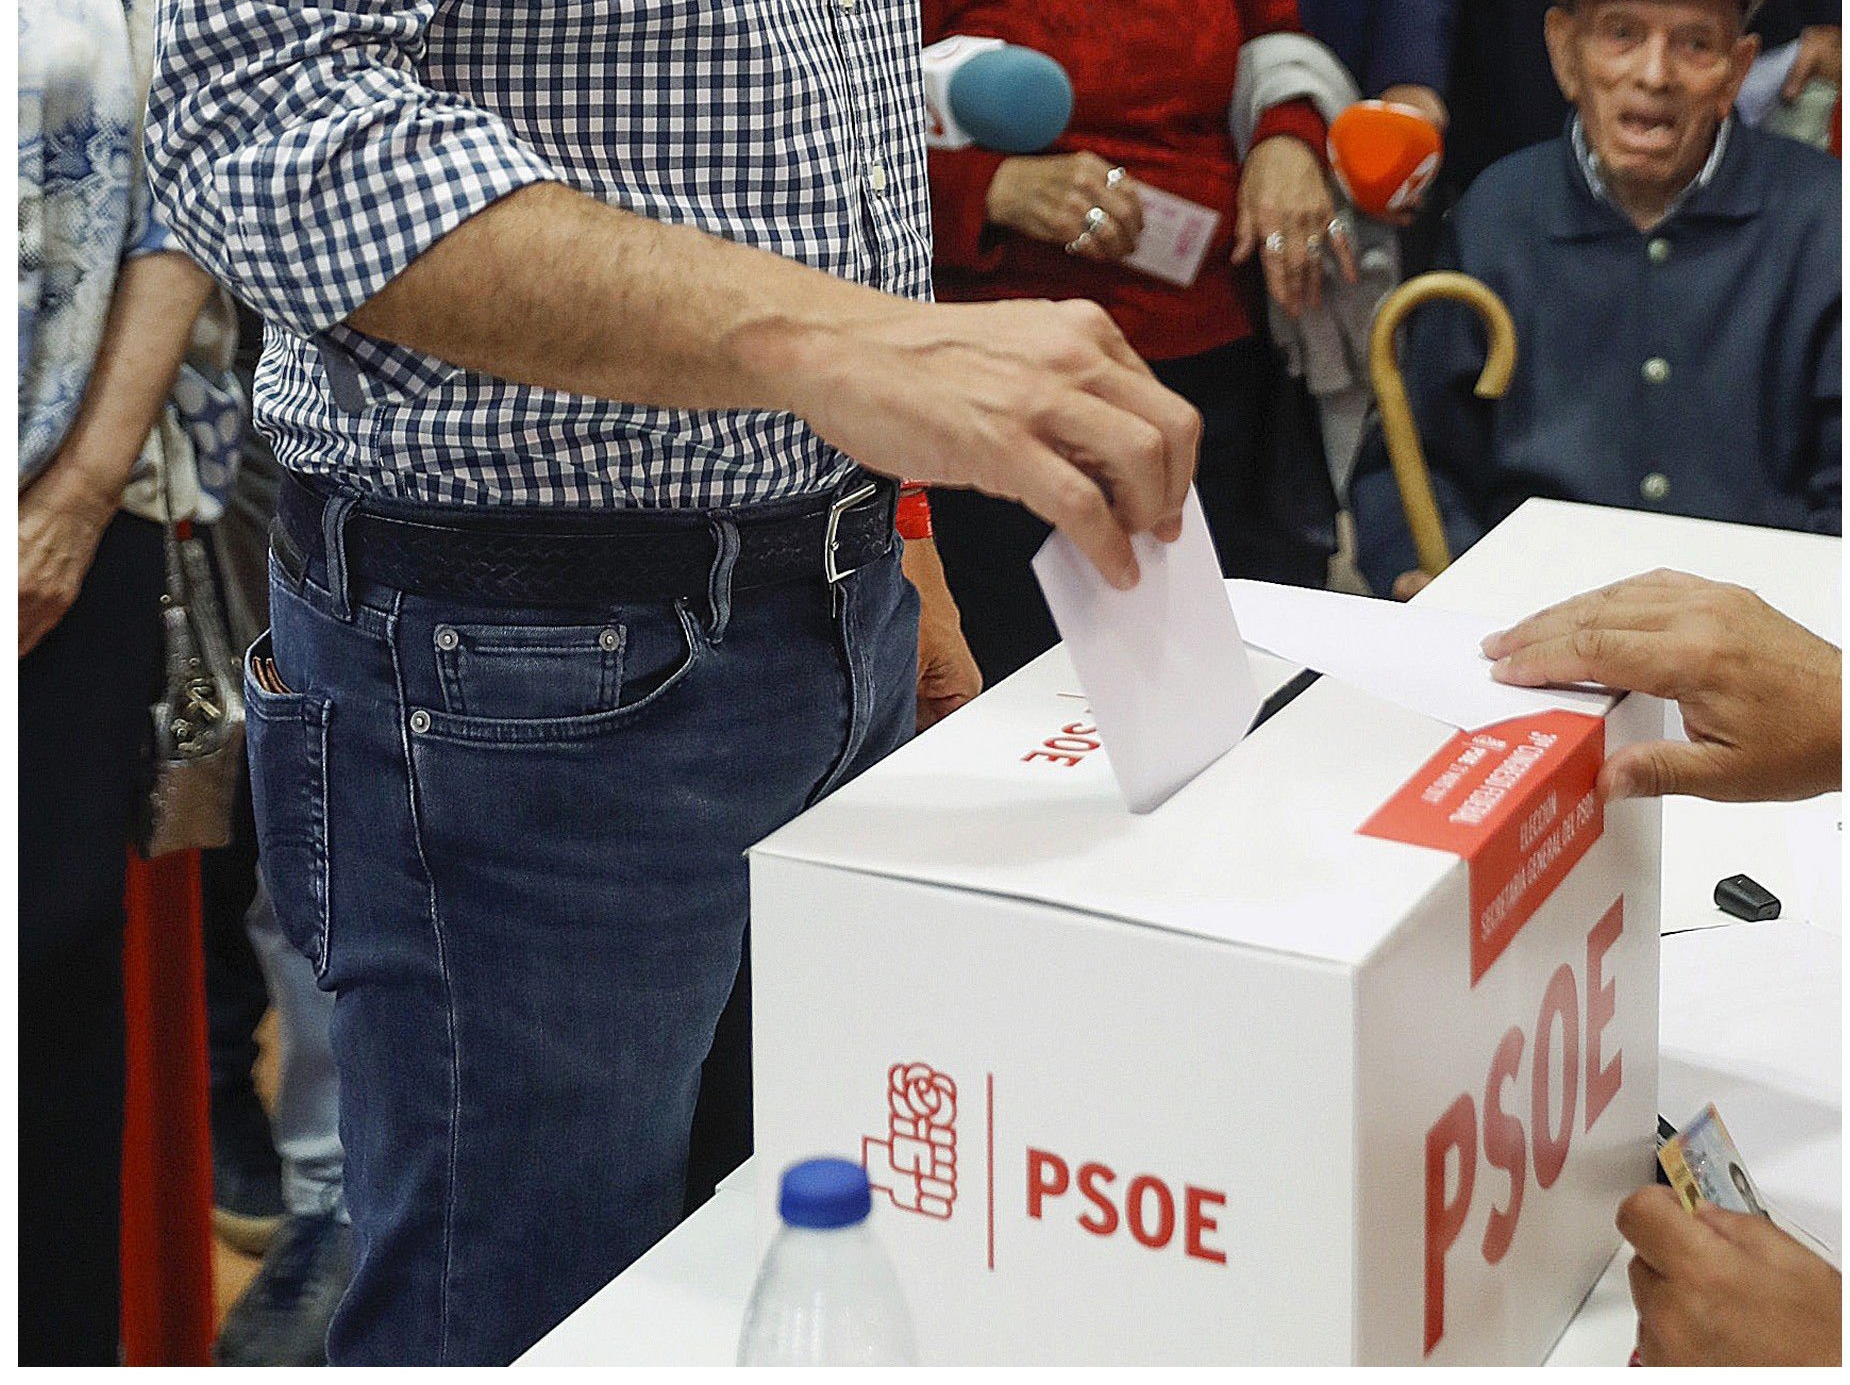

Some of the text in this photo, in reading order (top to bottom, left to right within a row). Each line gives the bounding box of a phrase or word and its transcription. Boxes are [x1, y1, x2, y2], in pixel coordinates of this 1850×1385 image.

[1020, 708, 1101, 767] SOE
[1423, 896, 1624, 1358] PSOE
[1026, 1147, 1228, 1266] PSOE
